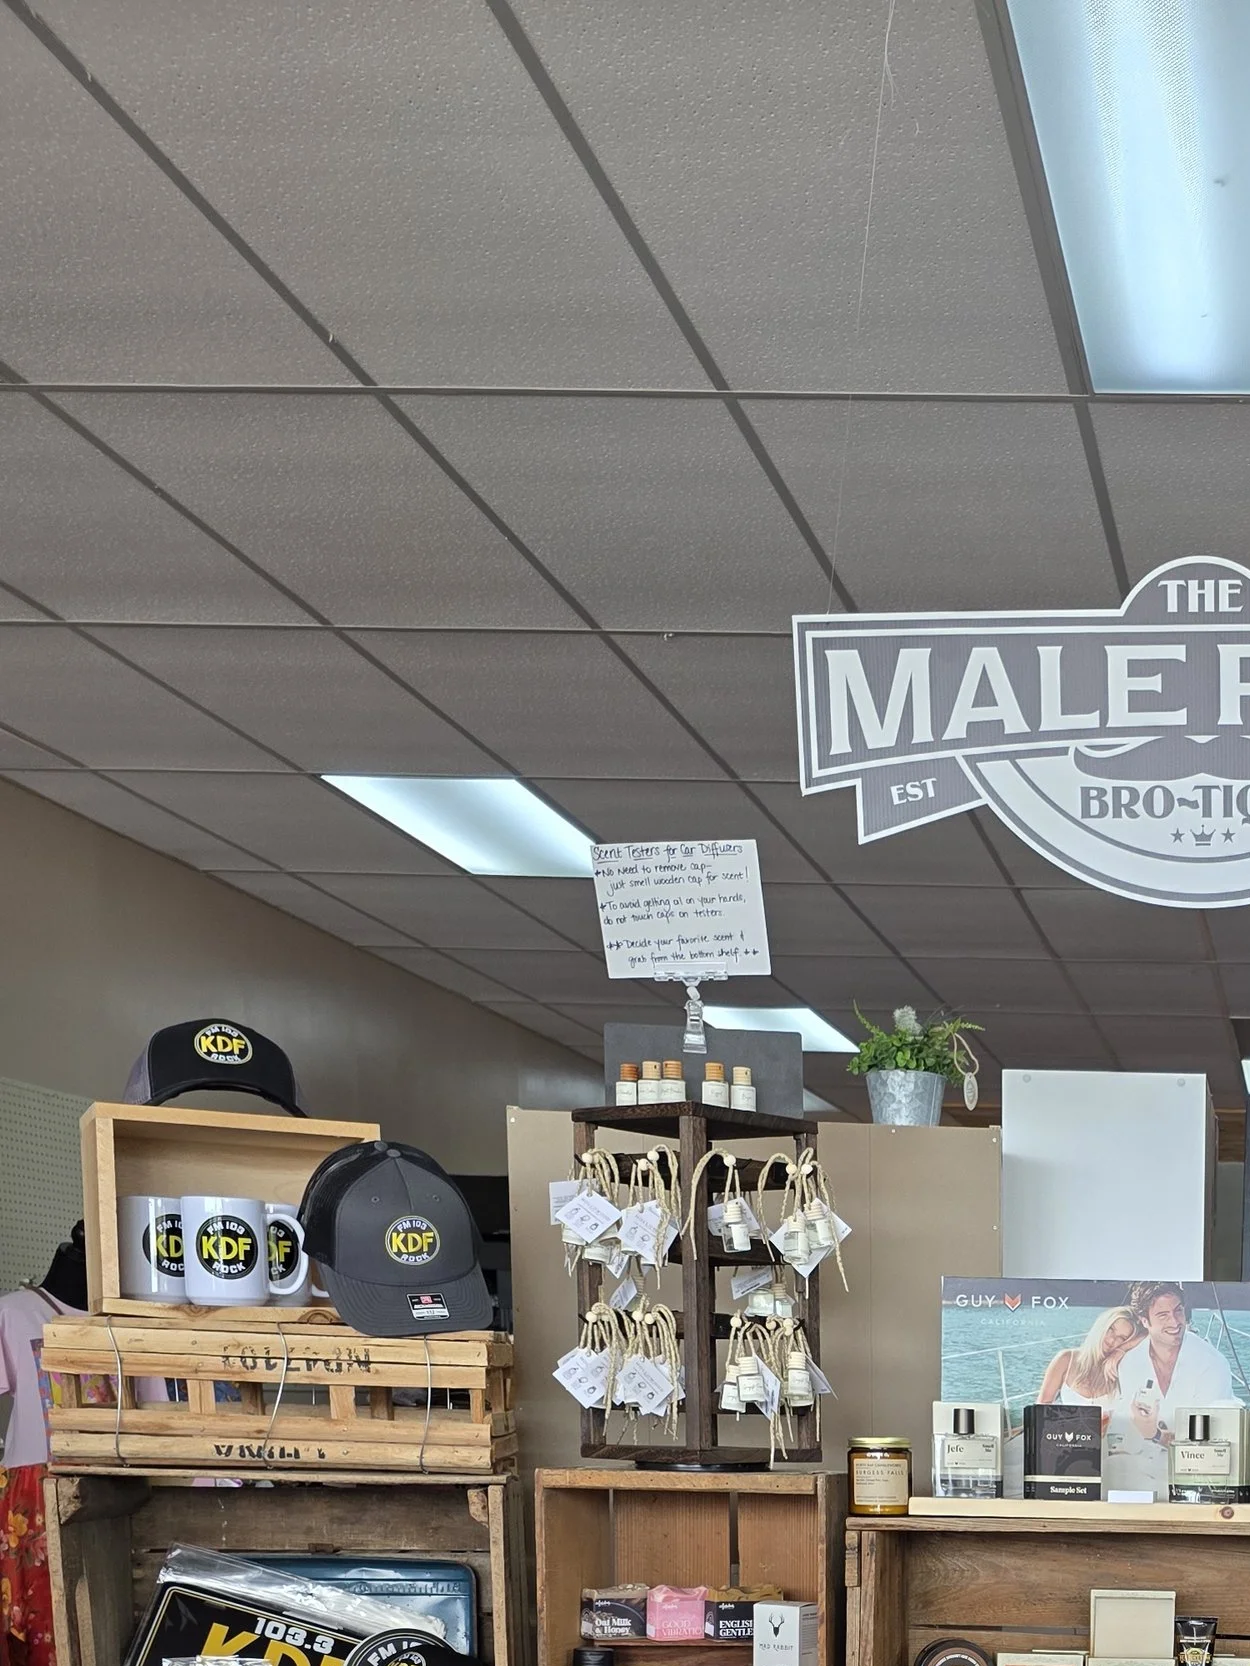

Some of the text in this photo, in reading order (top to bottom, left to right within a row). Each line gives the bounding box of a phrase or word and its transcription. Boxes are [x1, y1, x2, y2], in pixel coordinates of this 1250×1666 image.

[1158, 579, 1244, 614] THE
[825, 644, 1187, 756] MALE
[891, 776, 937, 806] EST
[591, 846, 622, 861] Scent
[624, 845, 659, 858] Testers
[664, 845, 676, 862] for
[680, 844, 694, 855] Car
[618, 865, 638, 875] Need
[642, 865, 651, 873] to
[655, 864, 686, 872] remove
[607, 881, 626, 897] just
[630, 878, 650, 887] smell
[654, 876, 685, 885] wooden
[688, 876, 702, 886] cap
[707, 874, 718, 884] for
[200, 1035, 246, 1054] KDF
[207, 1221, 246, 1234] FM 103
[397, 1222, 411, 1232] FM
[201, 1236, 252, 1260] KDF
[392, 1232, 433, 1252] KDF
[401, 1253, 430, 1261] ROCK
[212, 1261, 246, 1273] ROCK
[956, 1295, 1069, 1310] GUY FOX
[1047, 1433, 1062, 1441] GUY
[1181, 1451, 1205, 1459] Vince
[1050, 1486, 1073, 1495] Sample
[612, 1618, 631, 1626] Milk
[255, 1617, 334, 1654] 103.3
[602, 1626, 630, 1635] Honey
